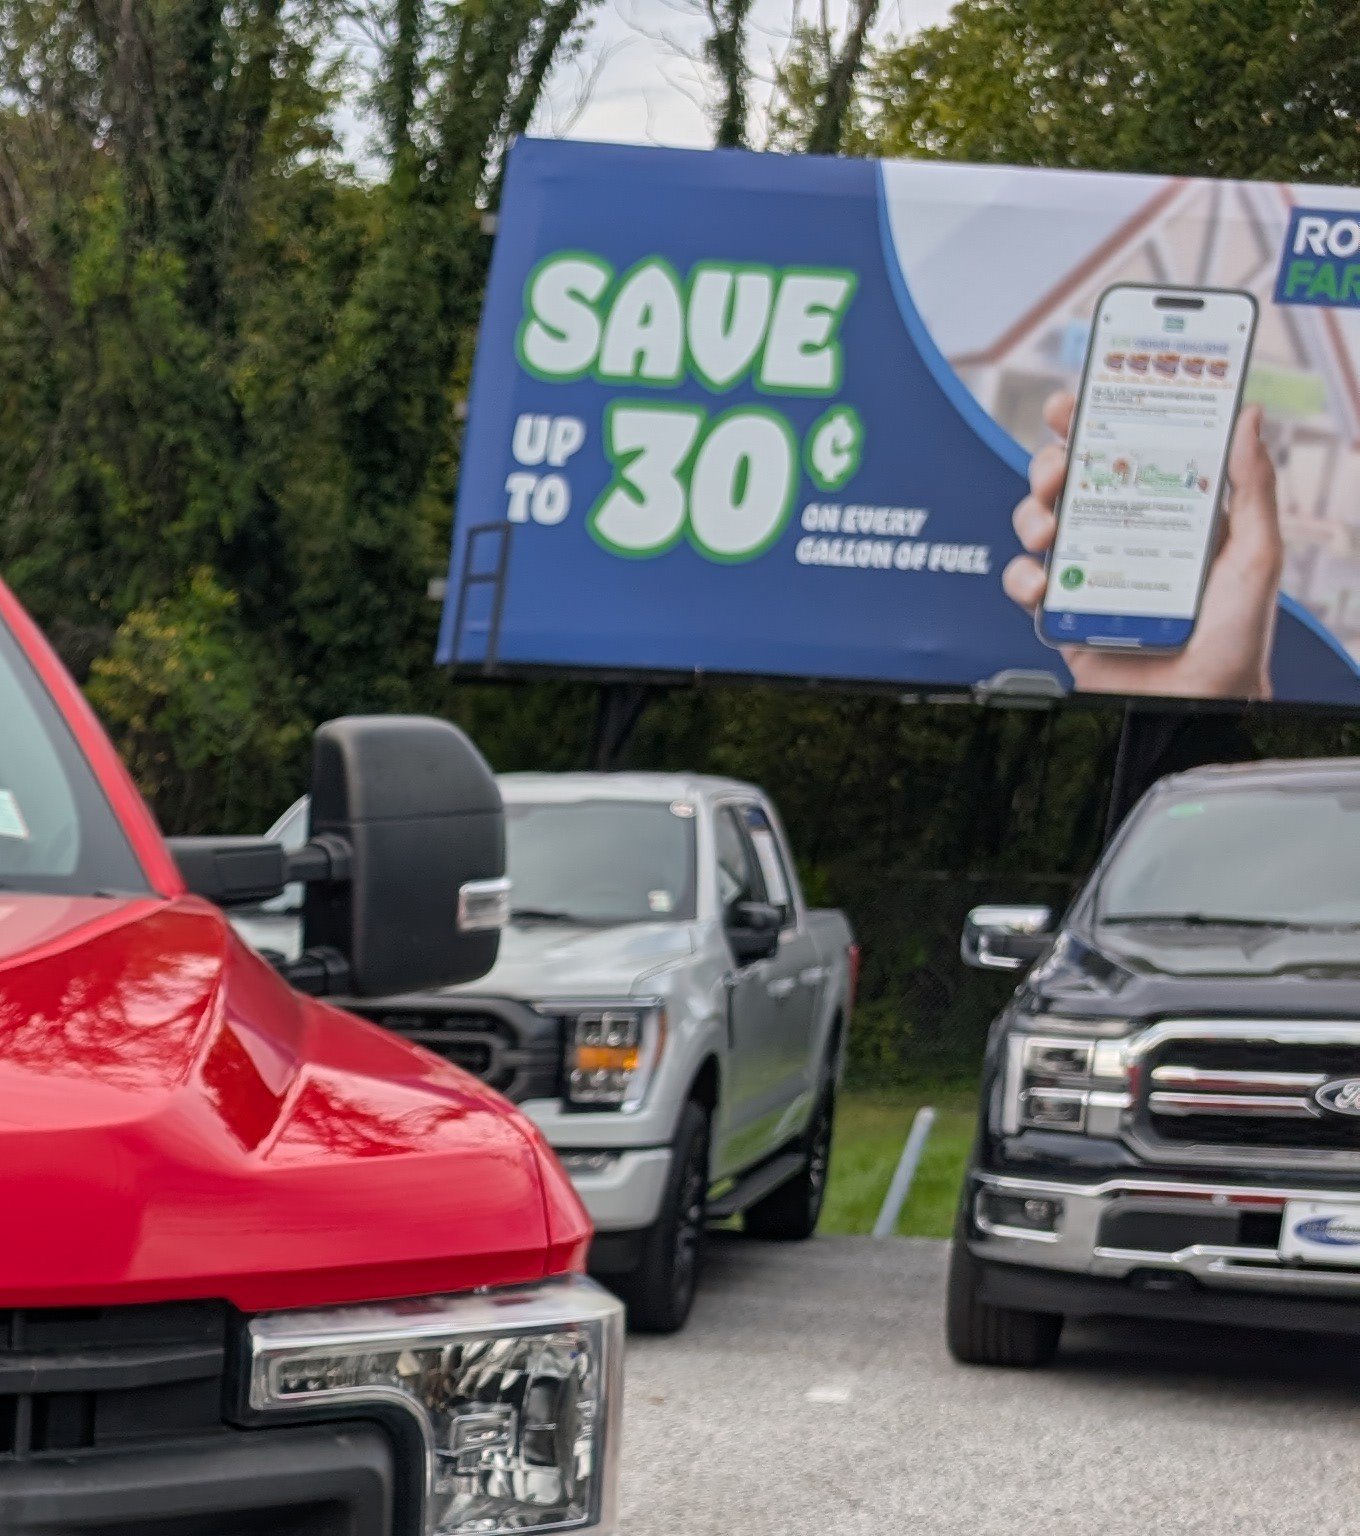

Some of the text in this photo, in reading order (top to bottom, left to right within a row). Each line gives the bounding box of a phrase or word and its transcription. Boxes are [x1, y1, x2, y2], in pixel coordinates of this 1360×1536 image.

[1293, 216, 1360, 258] RO
[519, 252, 857, 395] SAVE
[512, 412, 586, 468] UP
[505, 472, 570, 527] TO
[801, 503, 928, 538] ON EVERY
[795, 536, 992, 575] GALLON OF FUEL
